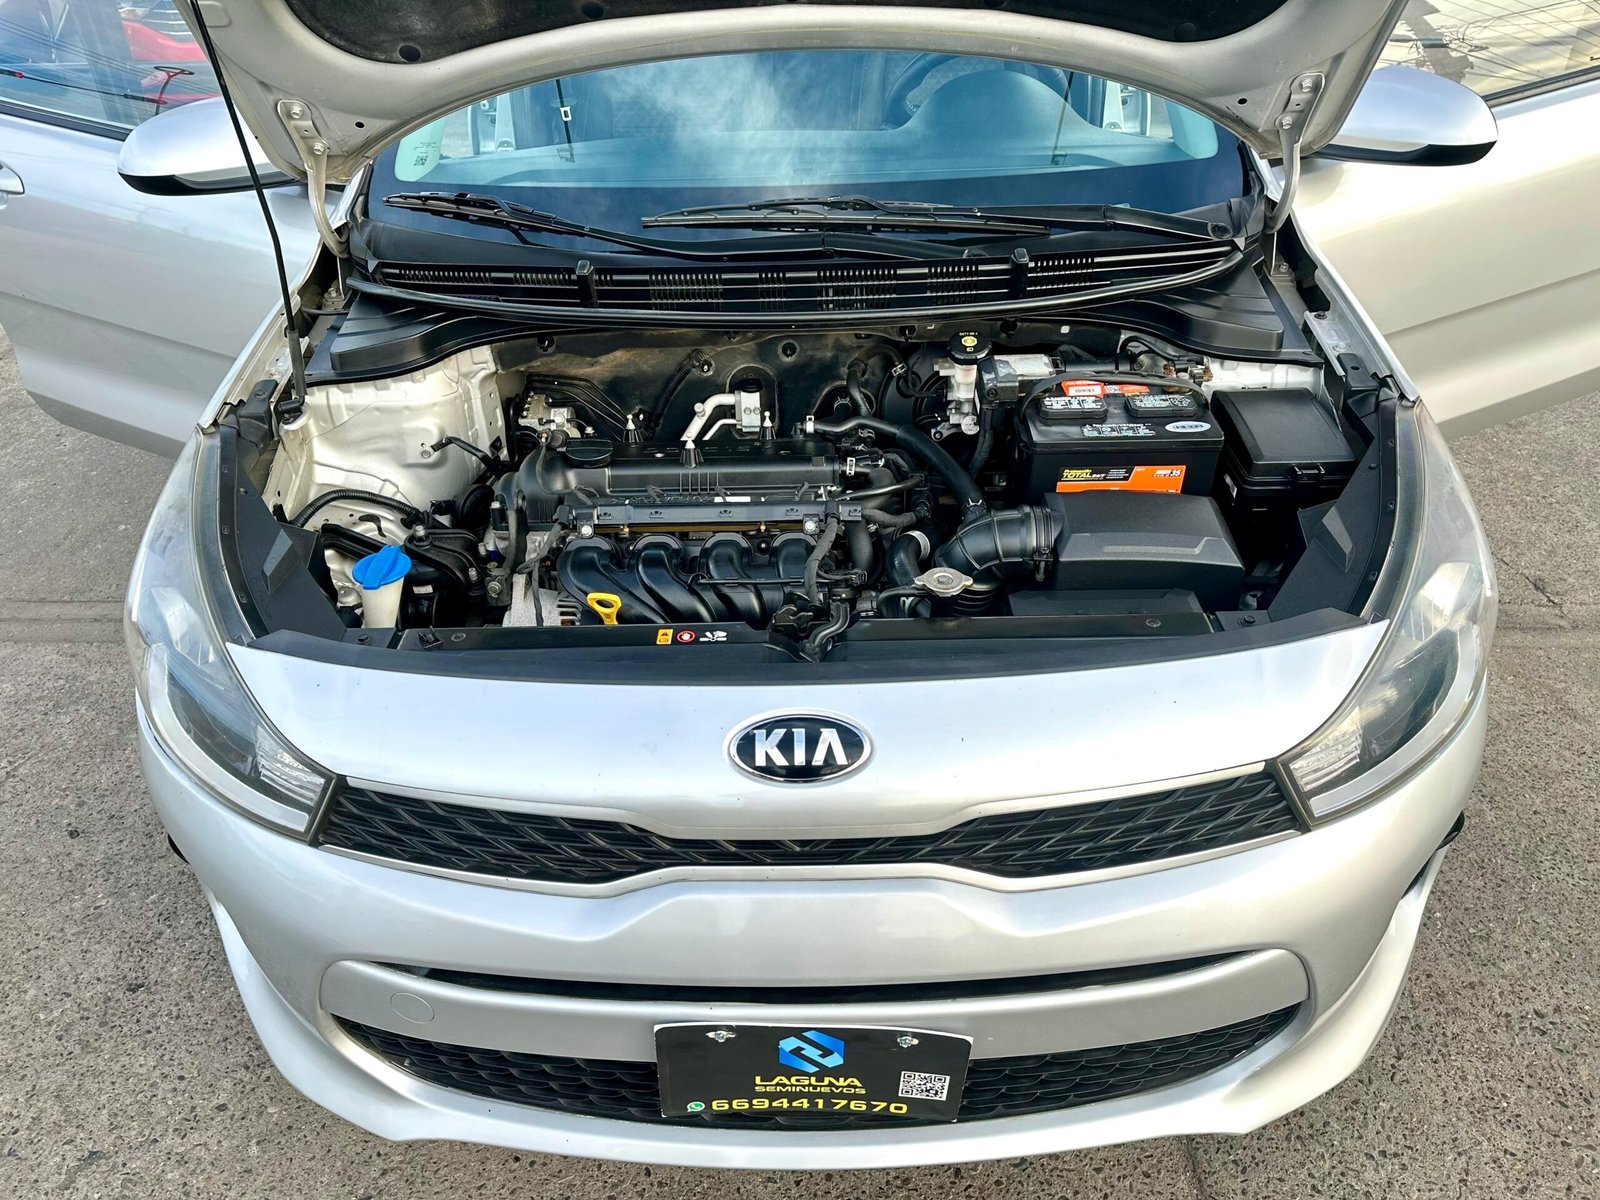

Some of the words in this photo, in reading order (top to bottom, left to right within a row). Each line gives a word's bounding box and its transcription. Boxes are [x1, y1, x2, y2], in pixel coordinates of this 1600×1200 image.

[753, 727, 849, 767] KIA
[755, 1075, 863, 1087] LAGUNA
[755, 1086, 867, 1094] SEMINUEVOS
[711, 1097, 908, 1115] 6694417670
